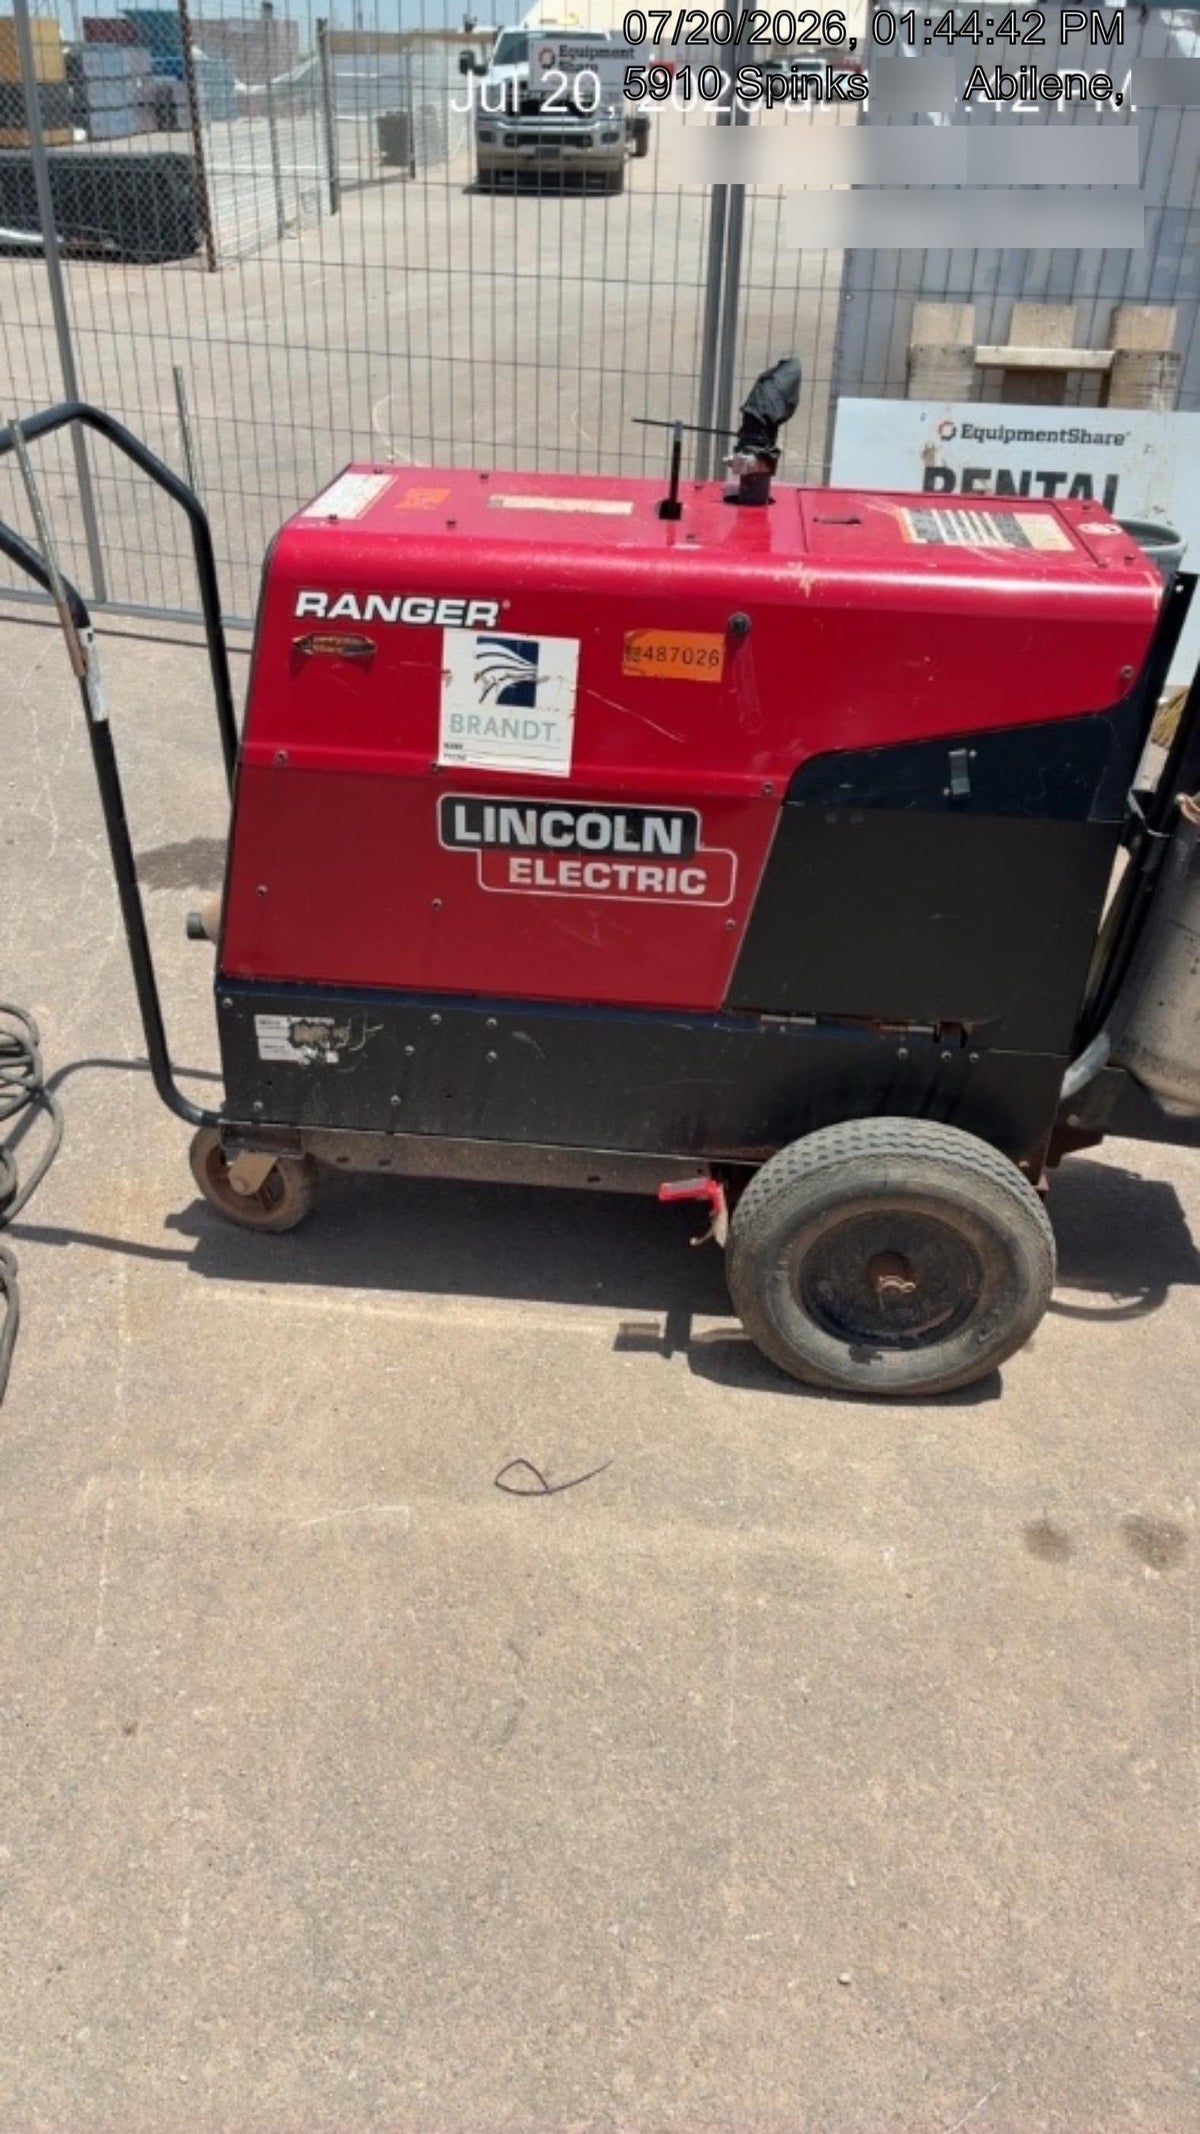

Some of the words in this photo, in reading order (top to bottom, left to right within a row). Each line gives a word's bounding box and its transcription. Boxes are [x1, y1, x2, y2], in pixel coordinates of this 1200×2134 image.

[960, 424, 1126, 446] EquipmentShare
[294, 591, 500, 627] RANGER
[642, 645, 719, 667] 487026
[449, 713, 558, 742] BRANDT
[454, 805, 682, 854] LINCOLN
[509, 857, 706, 895] ELECTRIC
